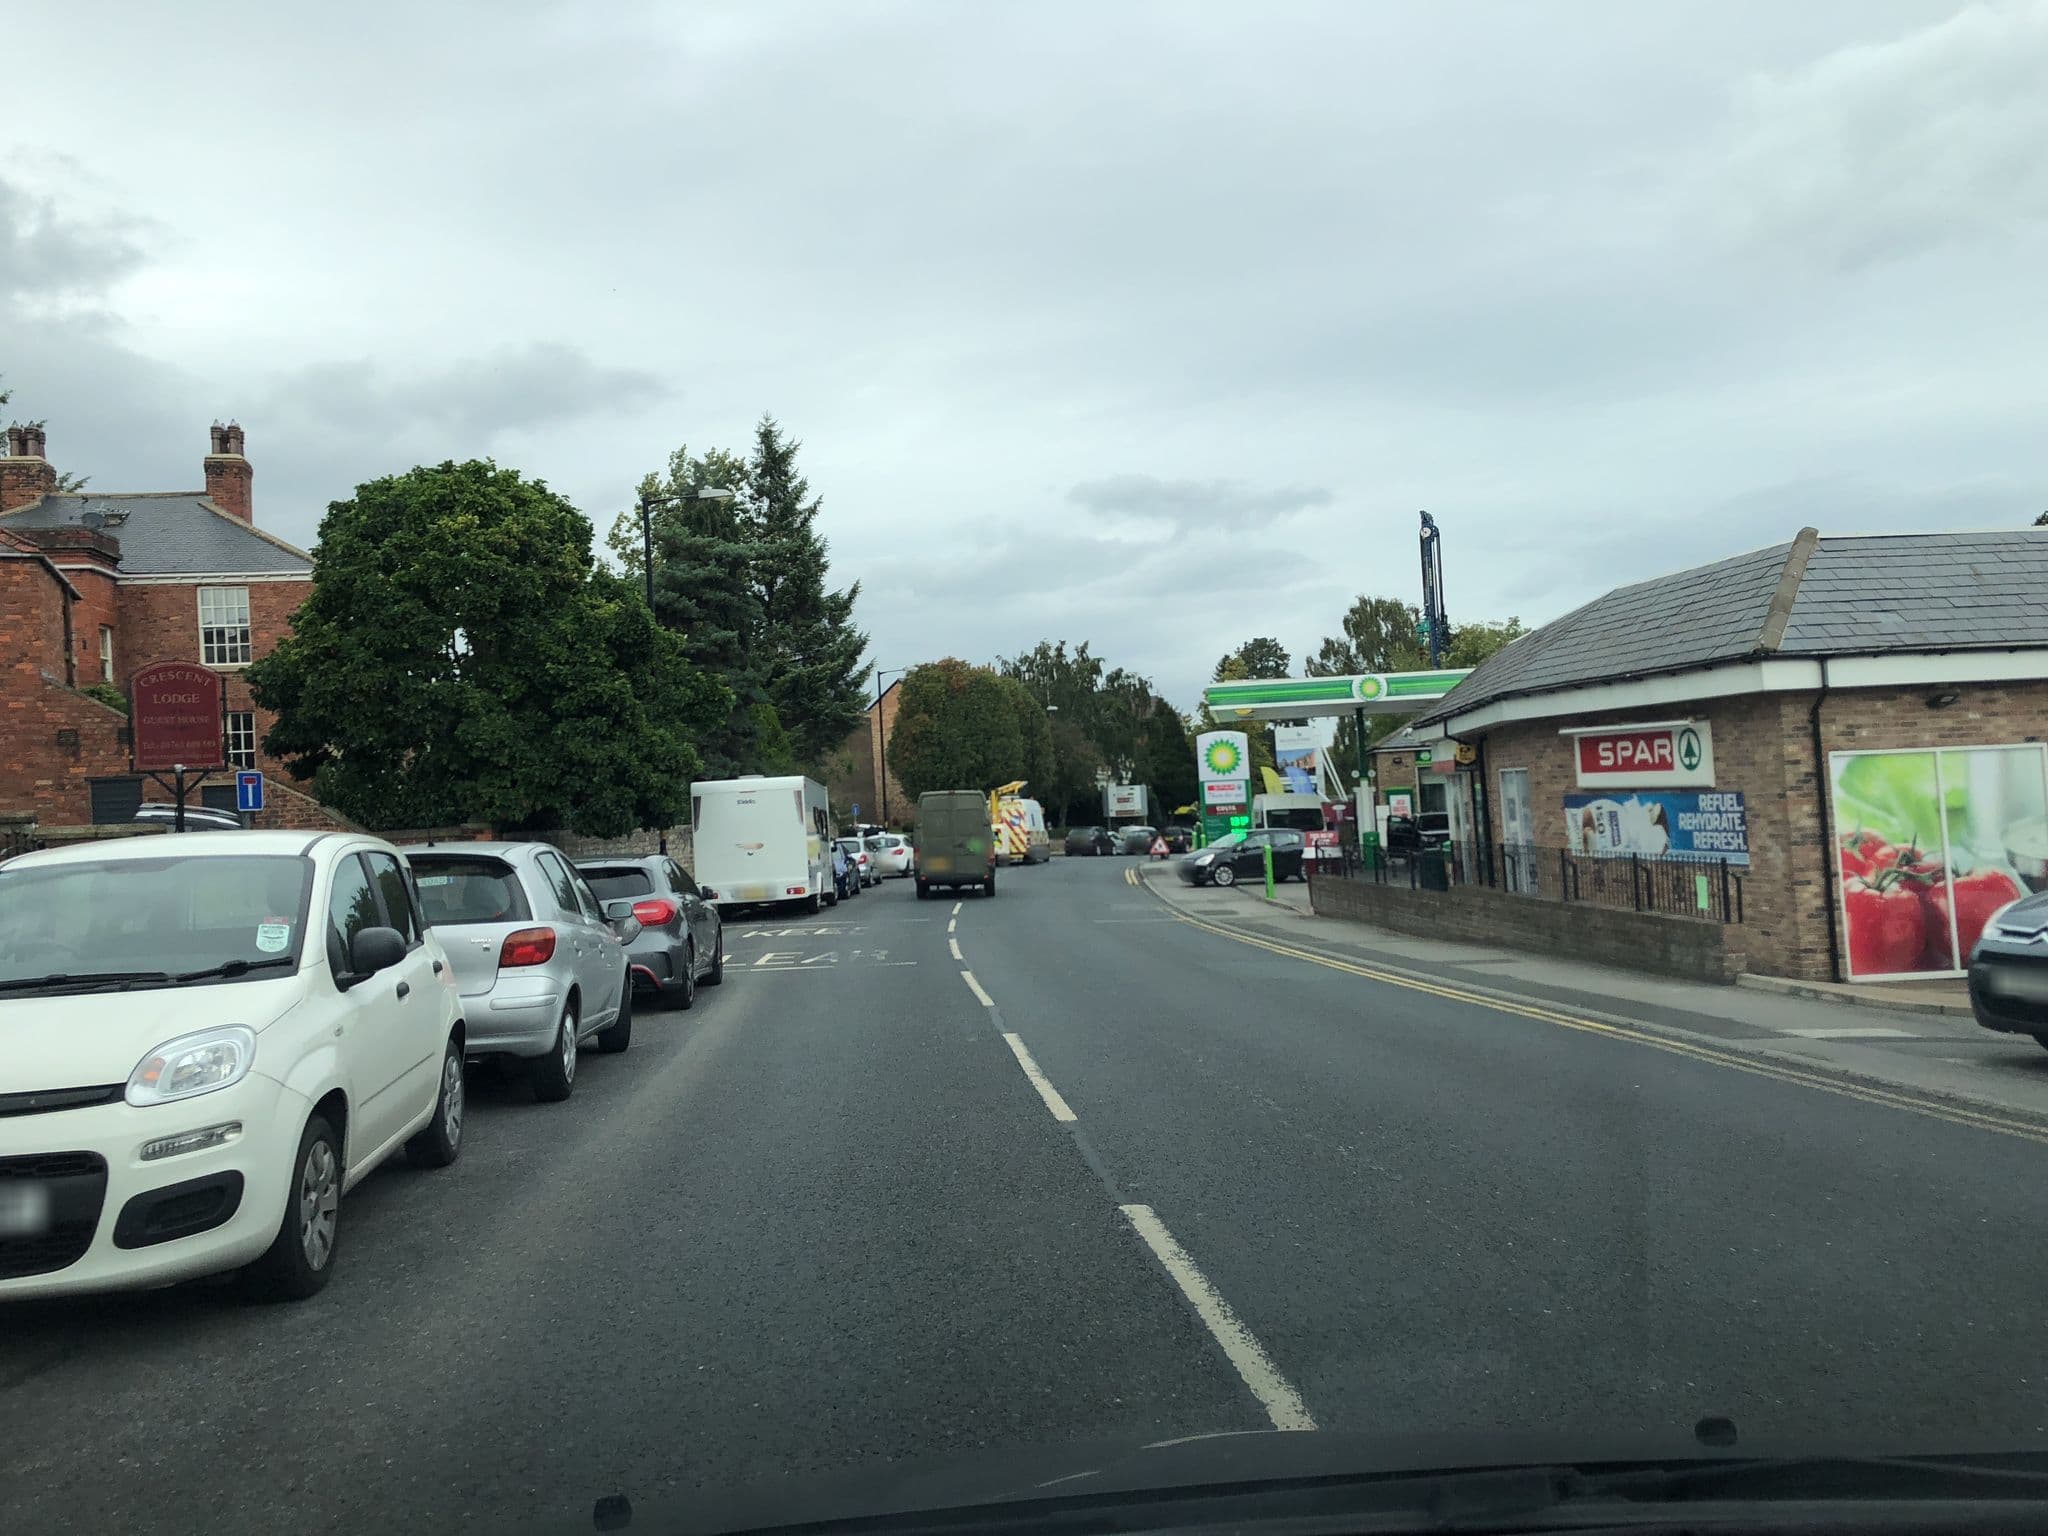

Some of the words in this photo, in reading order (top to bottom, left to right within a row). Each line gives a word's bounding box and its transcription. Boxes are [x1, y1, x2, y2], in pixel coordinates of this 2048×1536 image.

[140, 671, 210, 687] CRESCENT
[153, 693, 200, 704] LODGE
[1599, 738, 1672, 766] SPAR
[1698, 794, 1744, 811] REFUEL.
[1679, 813, 1746, 830] REHYDRATE.
[1693, 832, 1747, 850] REFRESH.
[721, 950, 889, 968] LEA
